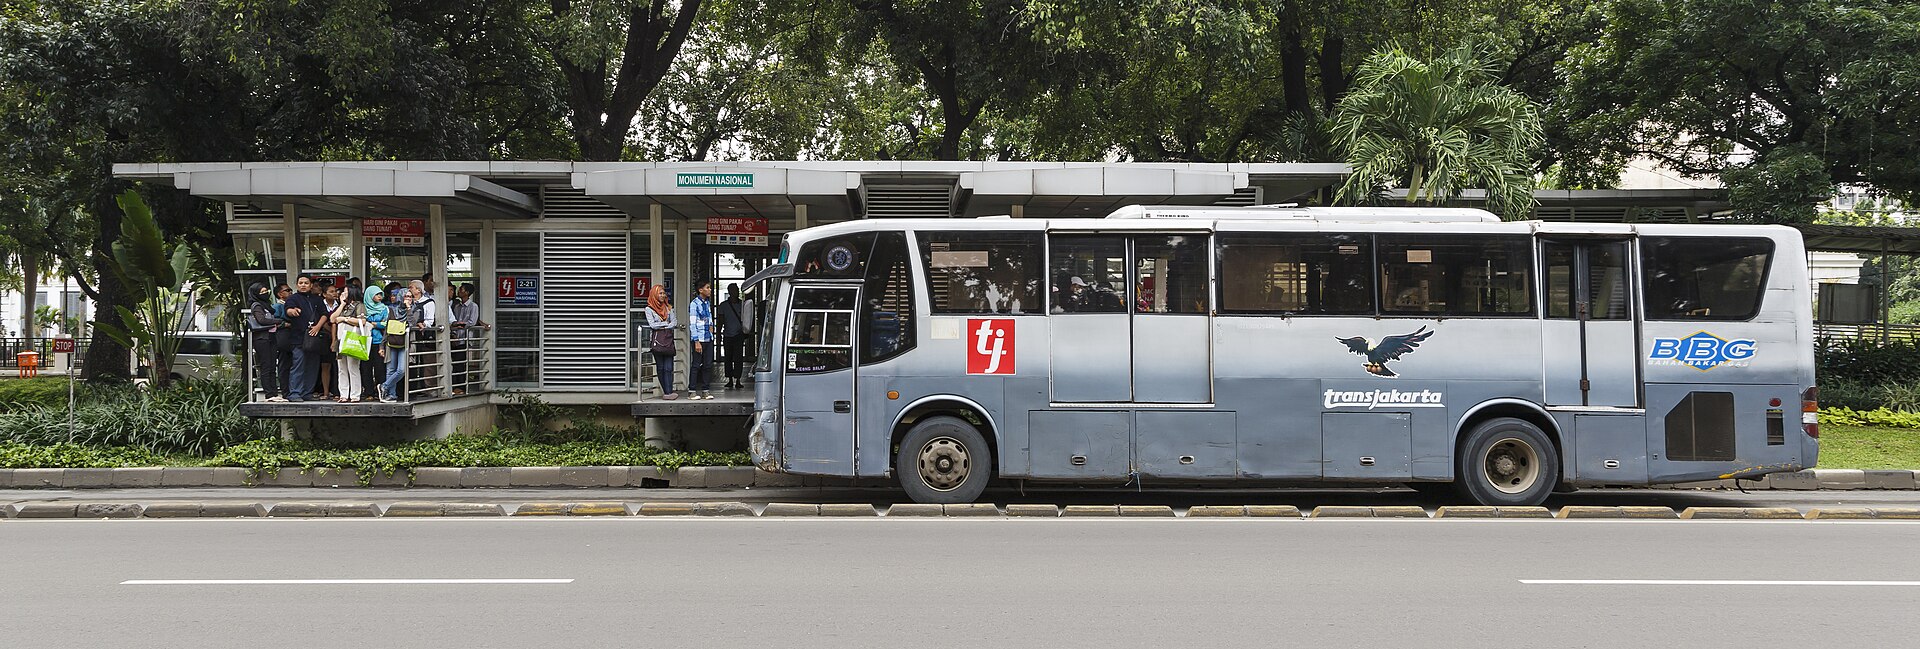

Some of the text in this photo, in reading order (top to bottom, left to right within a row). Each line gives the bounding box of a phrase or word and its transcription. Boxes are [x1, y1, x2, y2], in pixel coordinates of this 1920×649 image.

[678, 175, 752, 185] MONUMEN NASIONAL
[502, 279, 512, 296] tj
[636, 279, 646, 296] tj
[55, 341, 72, 350] STOP
[975, 319, 1007, 374] tj
[1647, 337, 1759, 361] BBG
[1323, 388, 1445, 410] transjakarta
